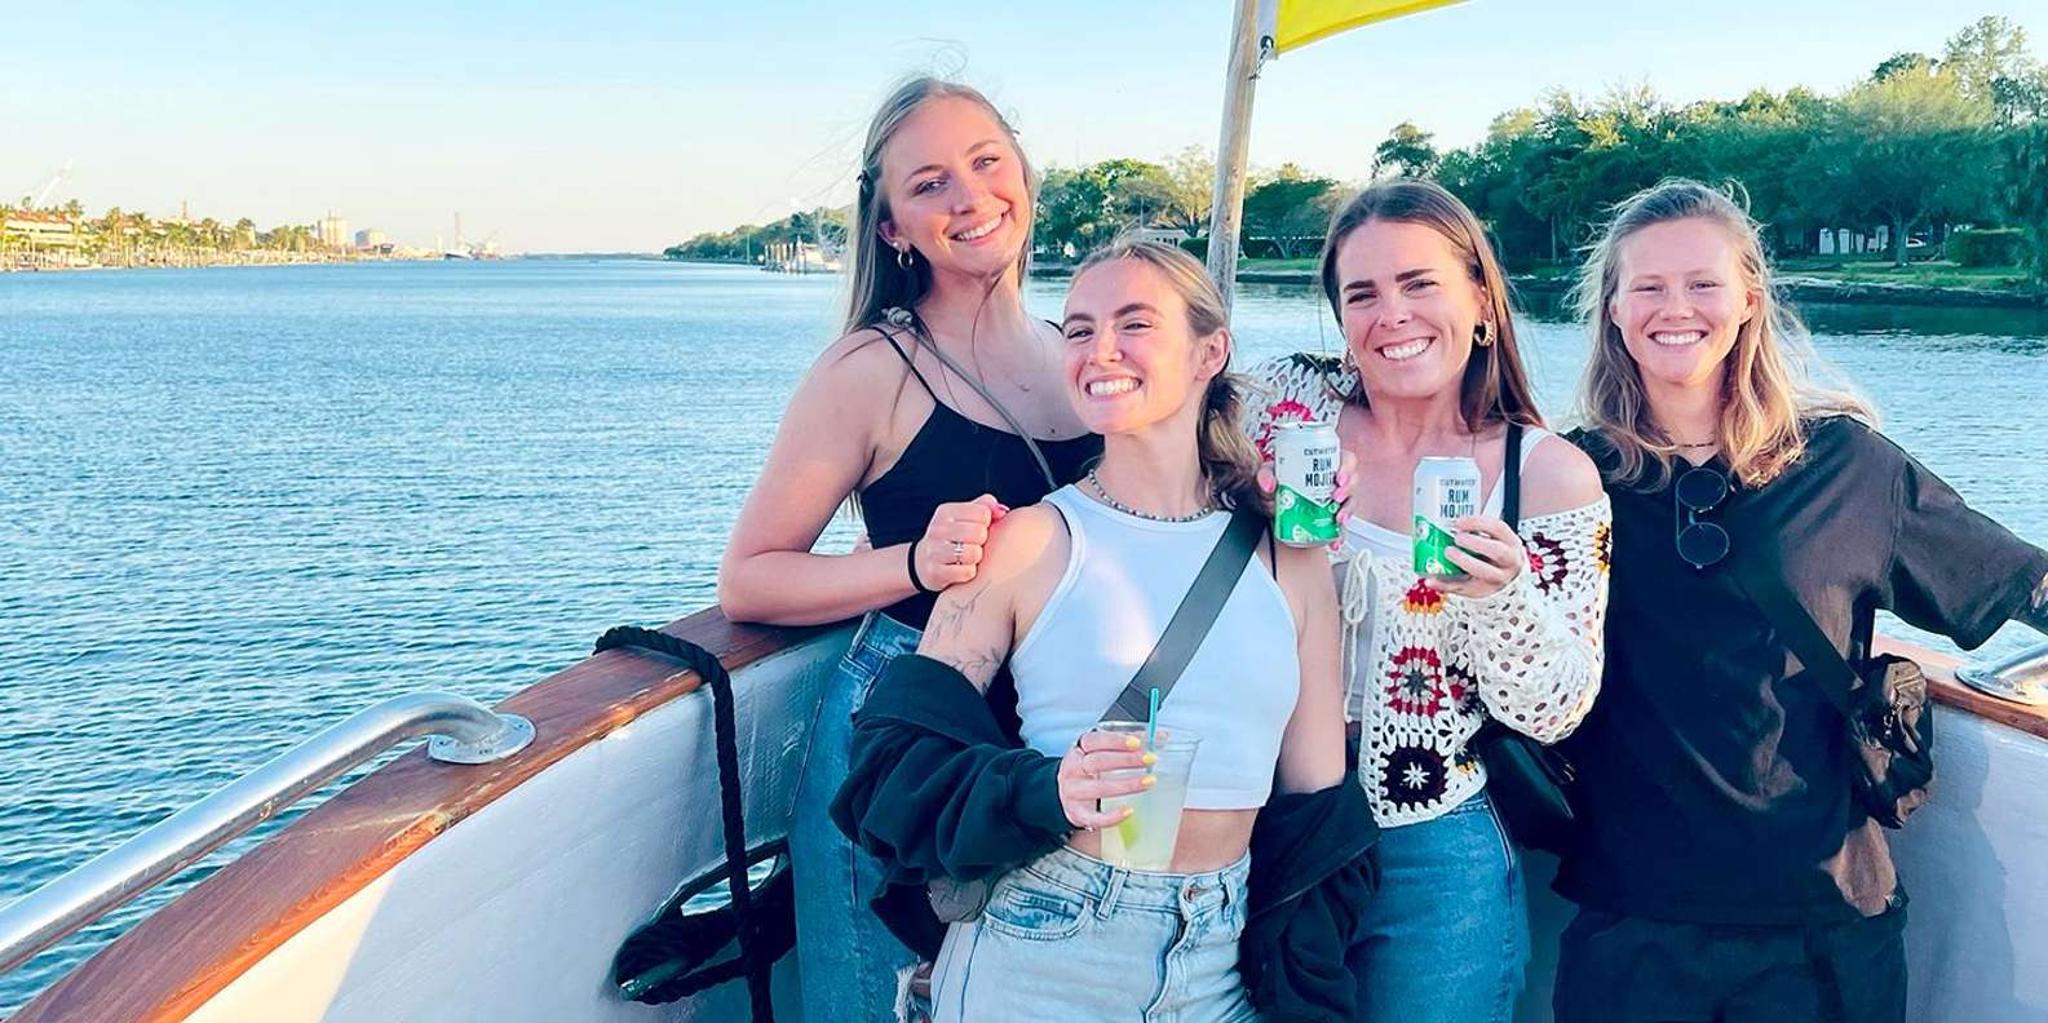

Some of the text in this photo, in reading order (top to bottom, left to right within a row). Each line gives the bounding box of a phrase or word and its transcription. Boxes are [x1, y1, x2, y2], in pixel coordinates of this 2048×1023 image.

[1313, 458, 1332, 472] RUM
[1448, 489, 1469, 503] RUM
[1440, 504, 1474, 518] MOJITO
